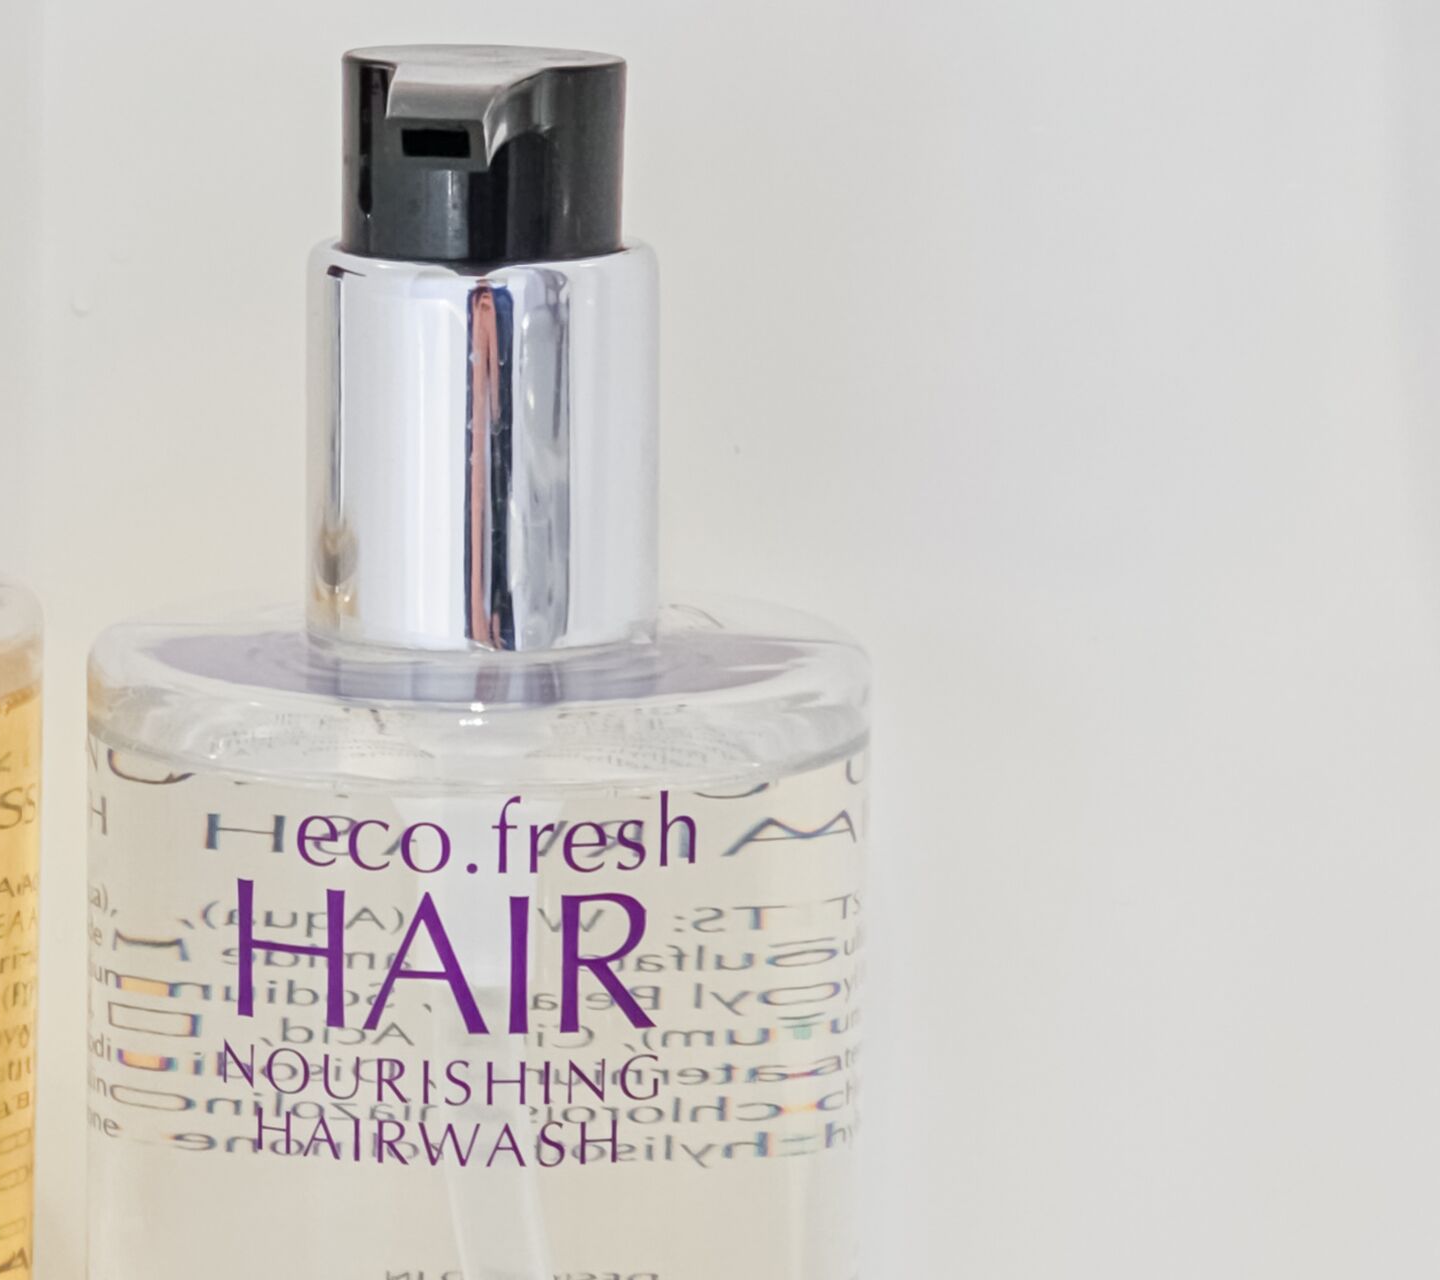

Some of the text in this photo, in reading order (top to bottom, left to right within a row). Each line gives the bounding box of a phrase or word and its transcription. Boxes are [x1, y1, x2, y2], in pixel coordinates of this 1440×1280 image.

[295, 790, 699, 875] eco.fresh
[236, 876, 657, 1036] HAIR
[221, 1039, 664, 1108] NOURISHING
[254, 1106, 622, 1170] HAIRWASH
